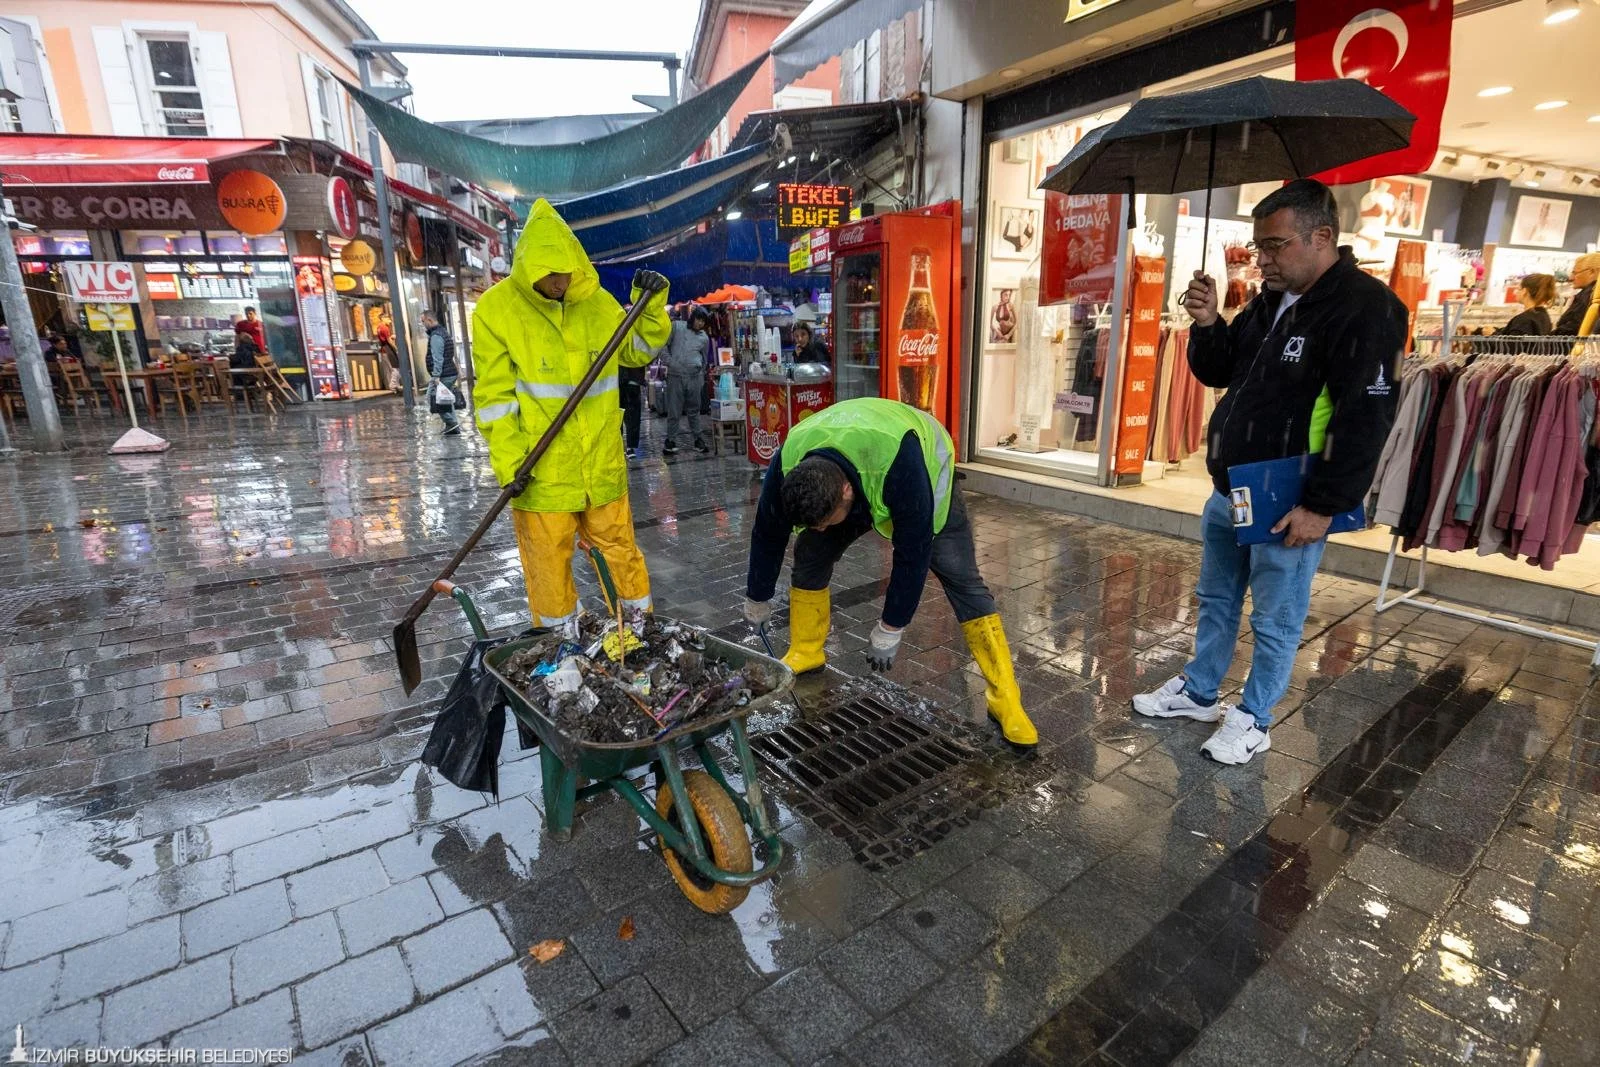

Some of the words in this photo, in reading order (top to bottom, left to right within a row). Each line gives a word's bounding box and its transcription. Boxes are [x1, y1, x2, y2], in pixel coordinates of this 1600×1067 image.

[785, 187, 845, 206] TEKEL
[52, 196, 77, 219] &
[81, 196, 195, 224] ÇORBA
[1055, 218, 1061, 232] 1
[1063, 211, 1111, 231] BEDAVA
[70, 262, 133, 291] WC
[1140, 308, 1155, 321] SALE
[898, 333, 940, 357] Coca-Cola
[1131, 380, 1146, 392] SALE
[1125, 449, 1139, 460] SALE
